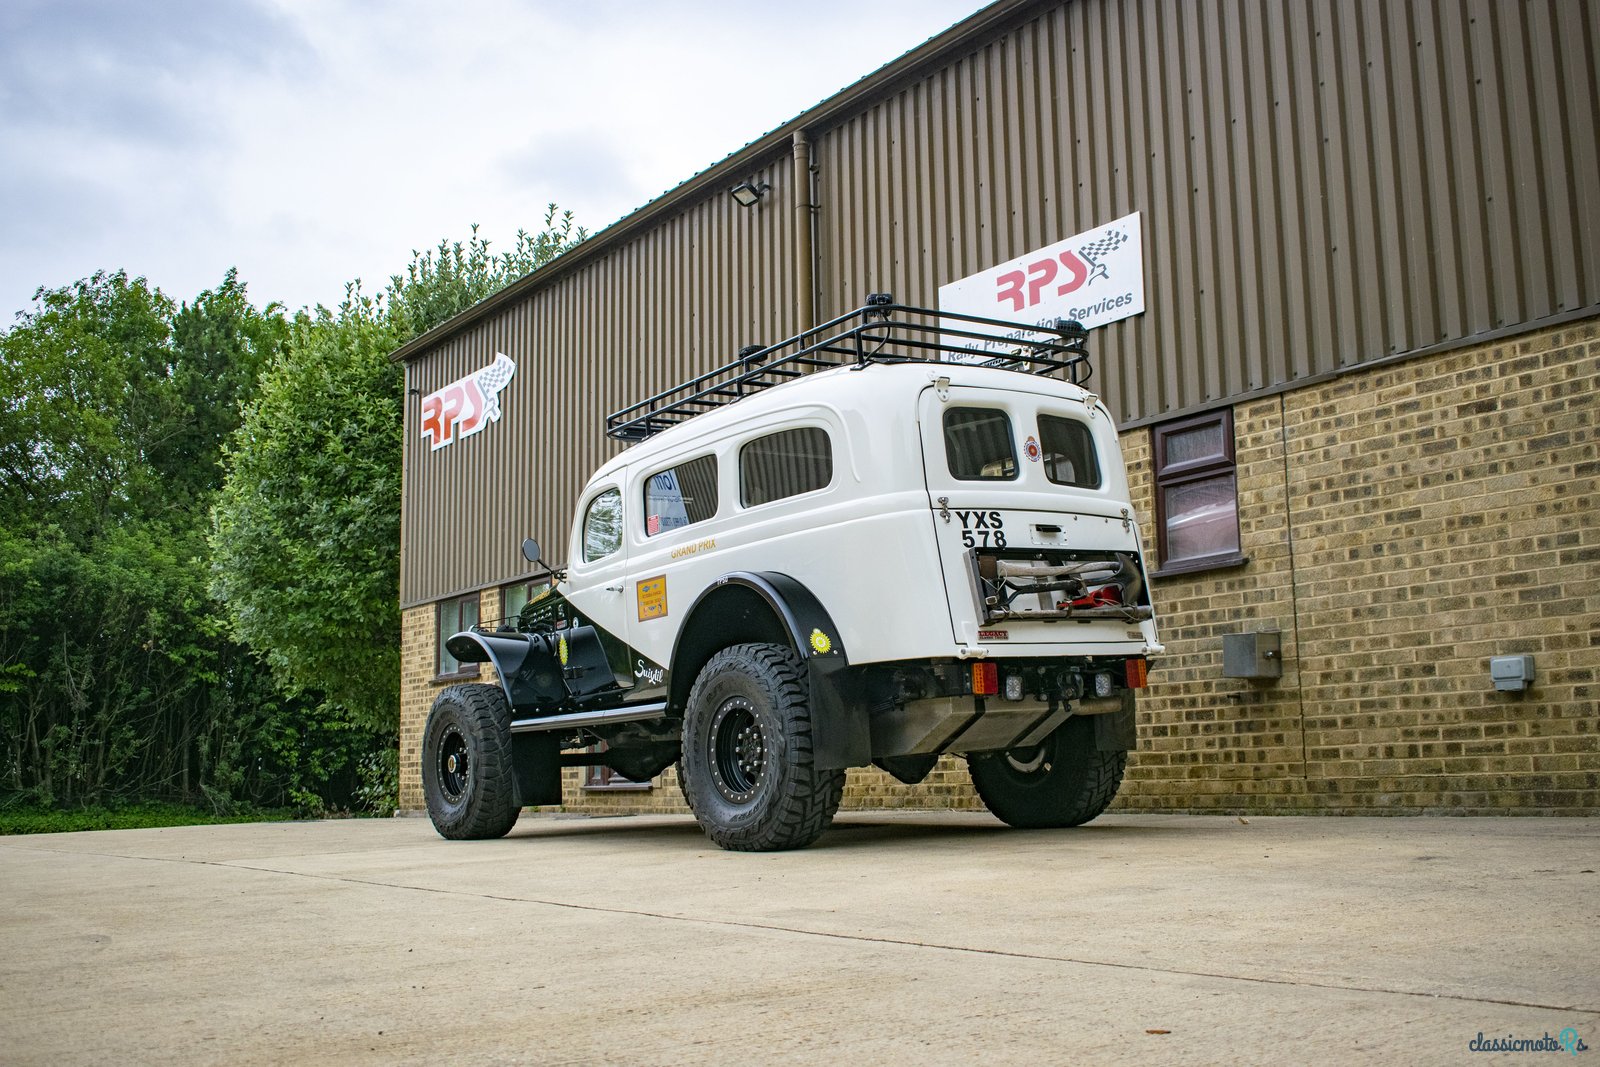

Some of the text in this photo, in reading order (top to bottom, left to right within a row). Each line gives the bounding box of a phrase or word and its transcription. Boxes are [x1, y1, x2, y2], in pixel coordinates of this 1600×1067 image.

[996, 249, 1088, 313] RPS
[1068, 291, 1133, 322] Services
[423, 378, 483, 445] RPS
[955, 511, 1003, 529] YXS
[671, 538, 716, 559] GRAND PRIX
[962, 530, 1007, 548] 578
